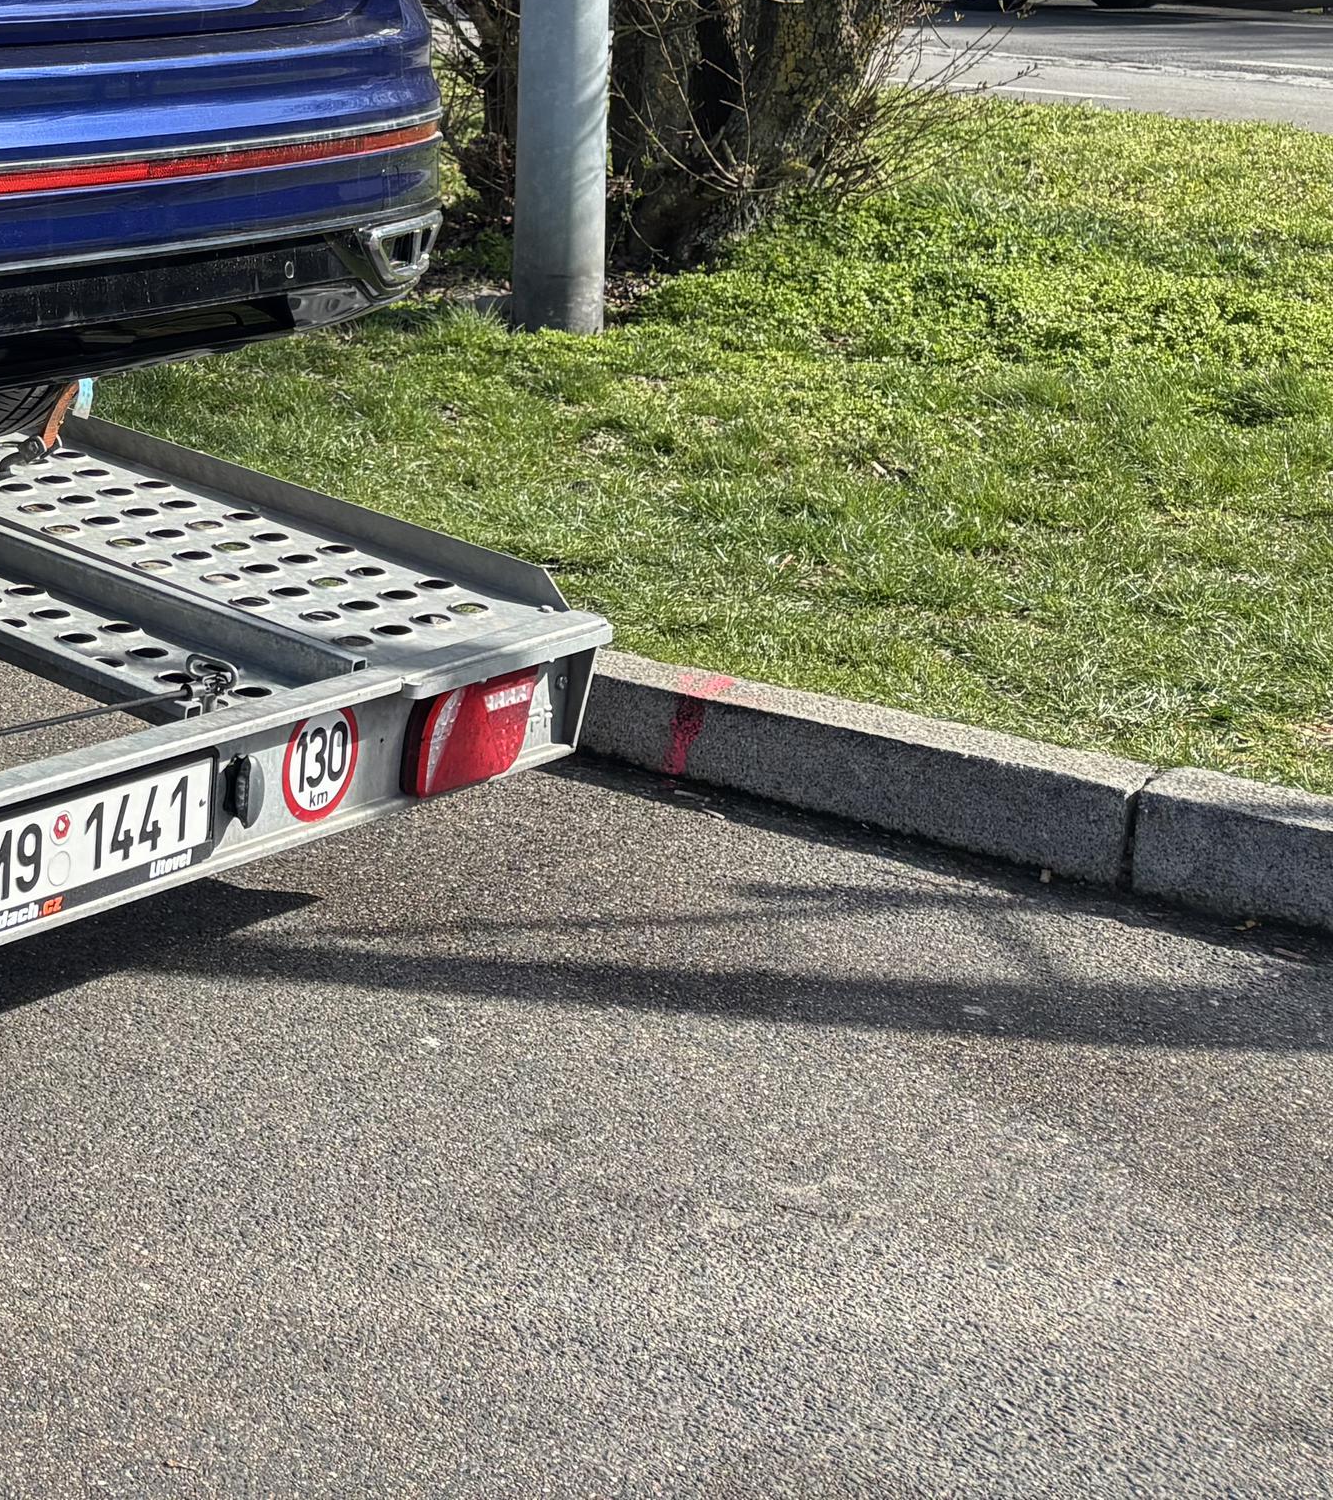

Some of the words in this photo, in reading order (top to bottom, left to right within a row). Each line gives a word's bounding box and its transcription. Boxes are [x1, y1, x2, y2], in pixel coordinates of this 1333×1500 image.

[296, 720, 349, 793] 130
[85, 775, 189, 870] 1441
[309, 791, 329, 808] km
[149, 849, 192, 878] Litovel
